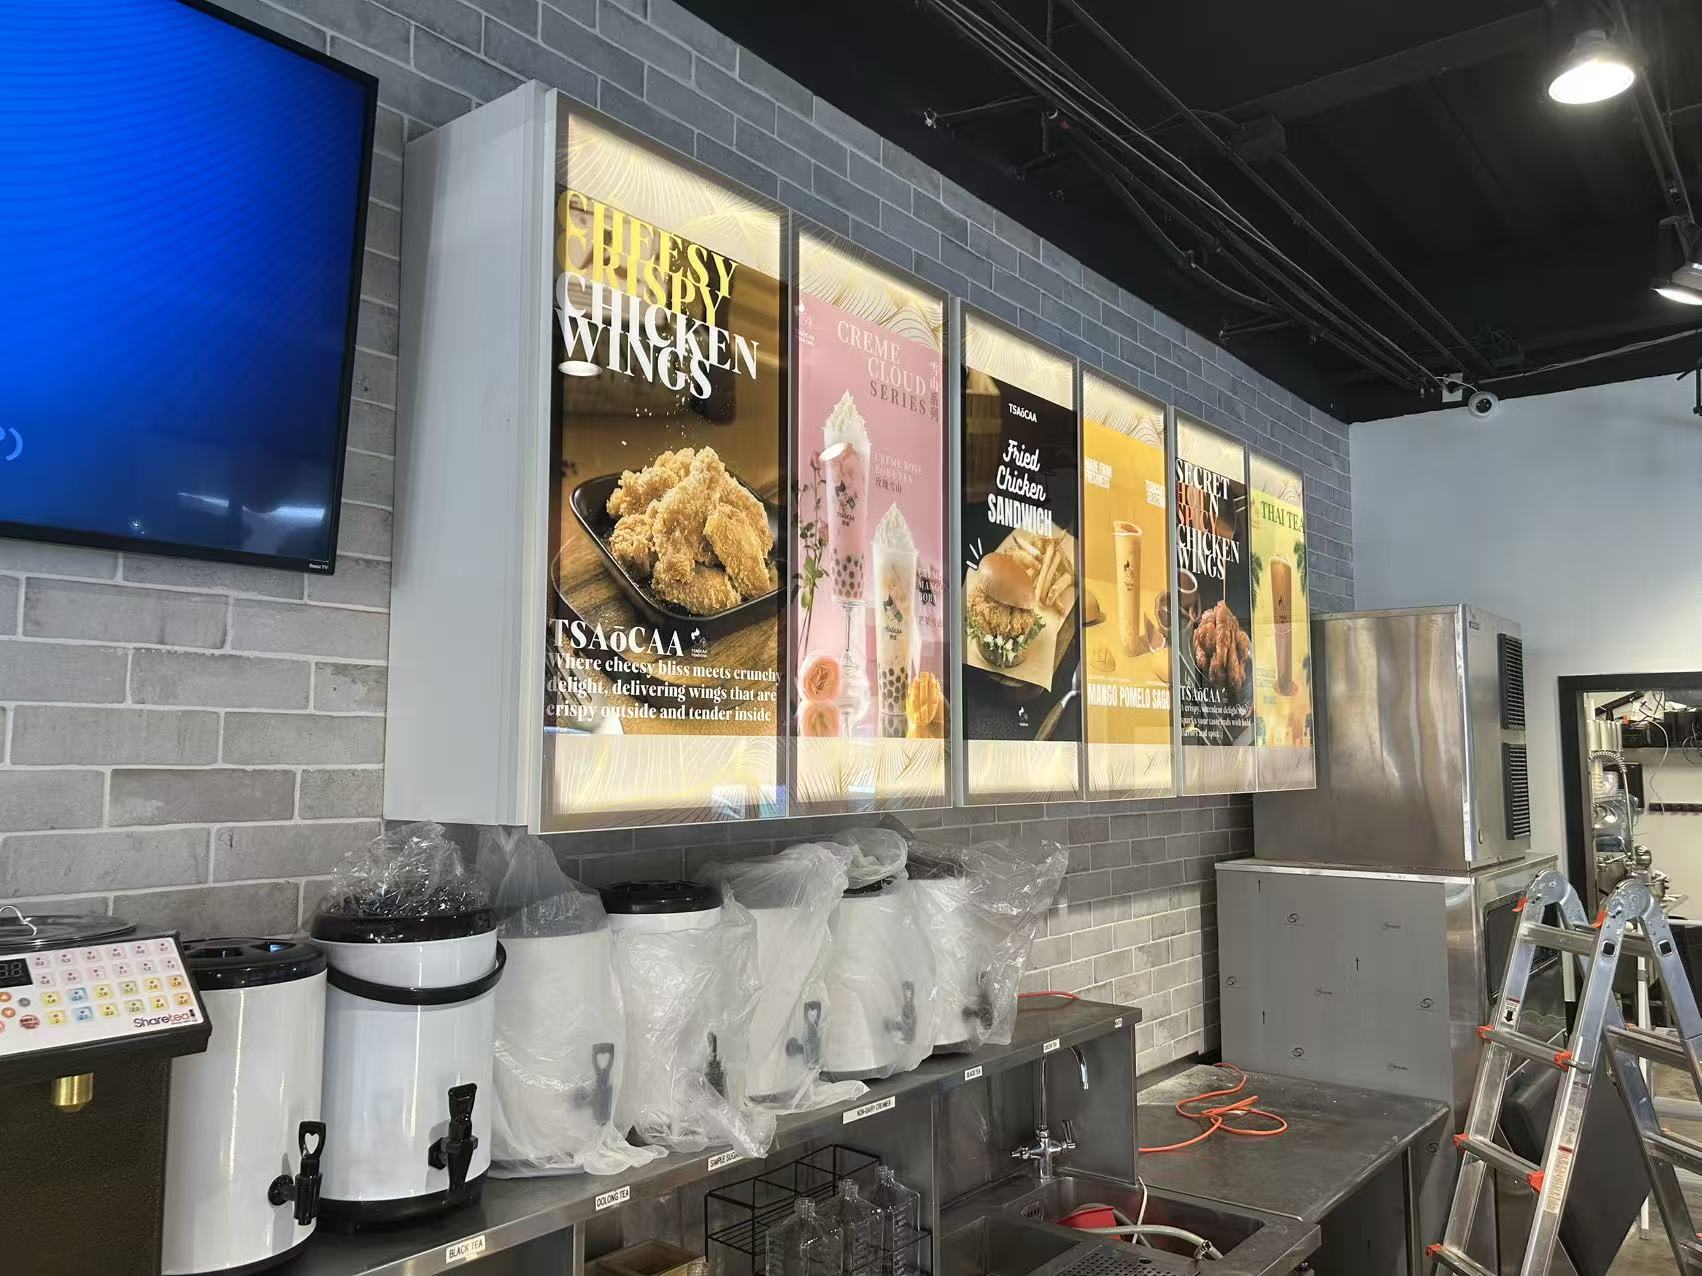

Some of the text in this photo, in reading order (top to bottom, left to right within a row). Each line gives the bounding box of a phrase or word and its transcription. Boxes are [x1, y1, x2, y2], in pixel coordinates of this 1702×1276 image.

[557, 190, 738, 299] CHEESY
[557, 227, 722, 327] CRISPY
[556, 271, 759, 380] CHICKEN
[837, 320, 900, 365] CREME
[553, 306, 712, 399] WINGS
[867, 357, 926, 396] CLOUD
[869, 380, 926, 415] SERIES
[1002, 439, 1041, 472] Fried
[996, 465, 1046, 501] Chicken
[1175, 458, 1230, 500] SECRET
[988, 494, 1052, 536] SANDWICH
[1260, 500, 1286, 527] THAI
[1177, 523, 1240, 564] CHICKEN
[1178, 547, 1226, 580] WINGS
[546, 652, 782, 686] Where cheesy bliss meets crunchy
[547, 676, 777, 703] delight, delivering wings that are
[1087, 682, 1117, 706] MANGO
[1119, 685, 1151, 709] POMELO
[547, 701, 771, 722] crispy outside and tender inside
[133, 1012, 191, 1028] Sharetea
[710, 1151, 739, 1168] SIMPLE SUG
[597, 1189, 629, 1207] OOLONG TEA
[449, 1239, 483, 1259] BLACK TEA
